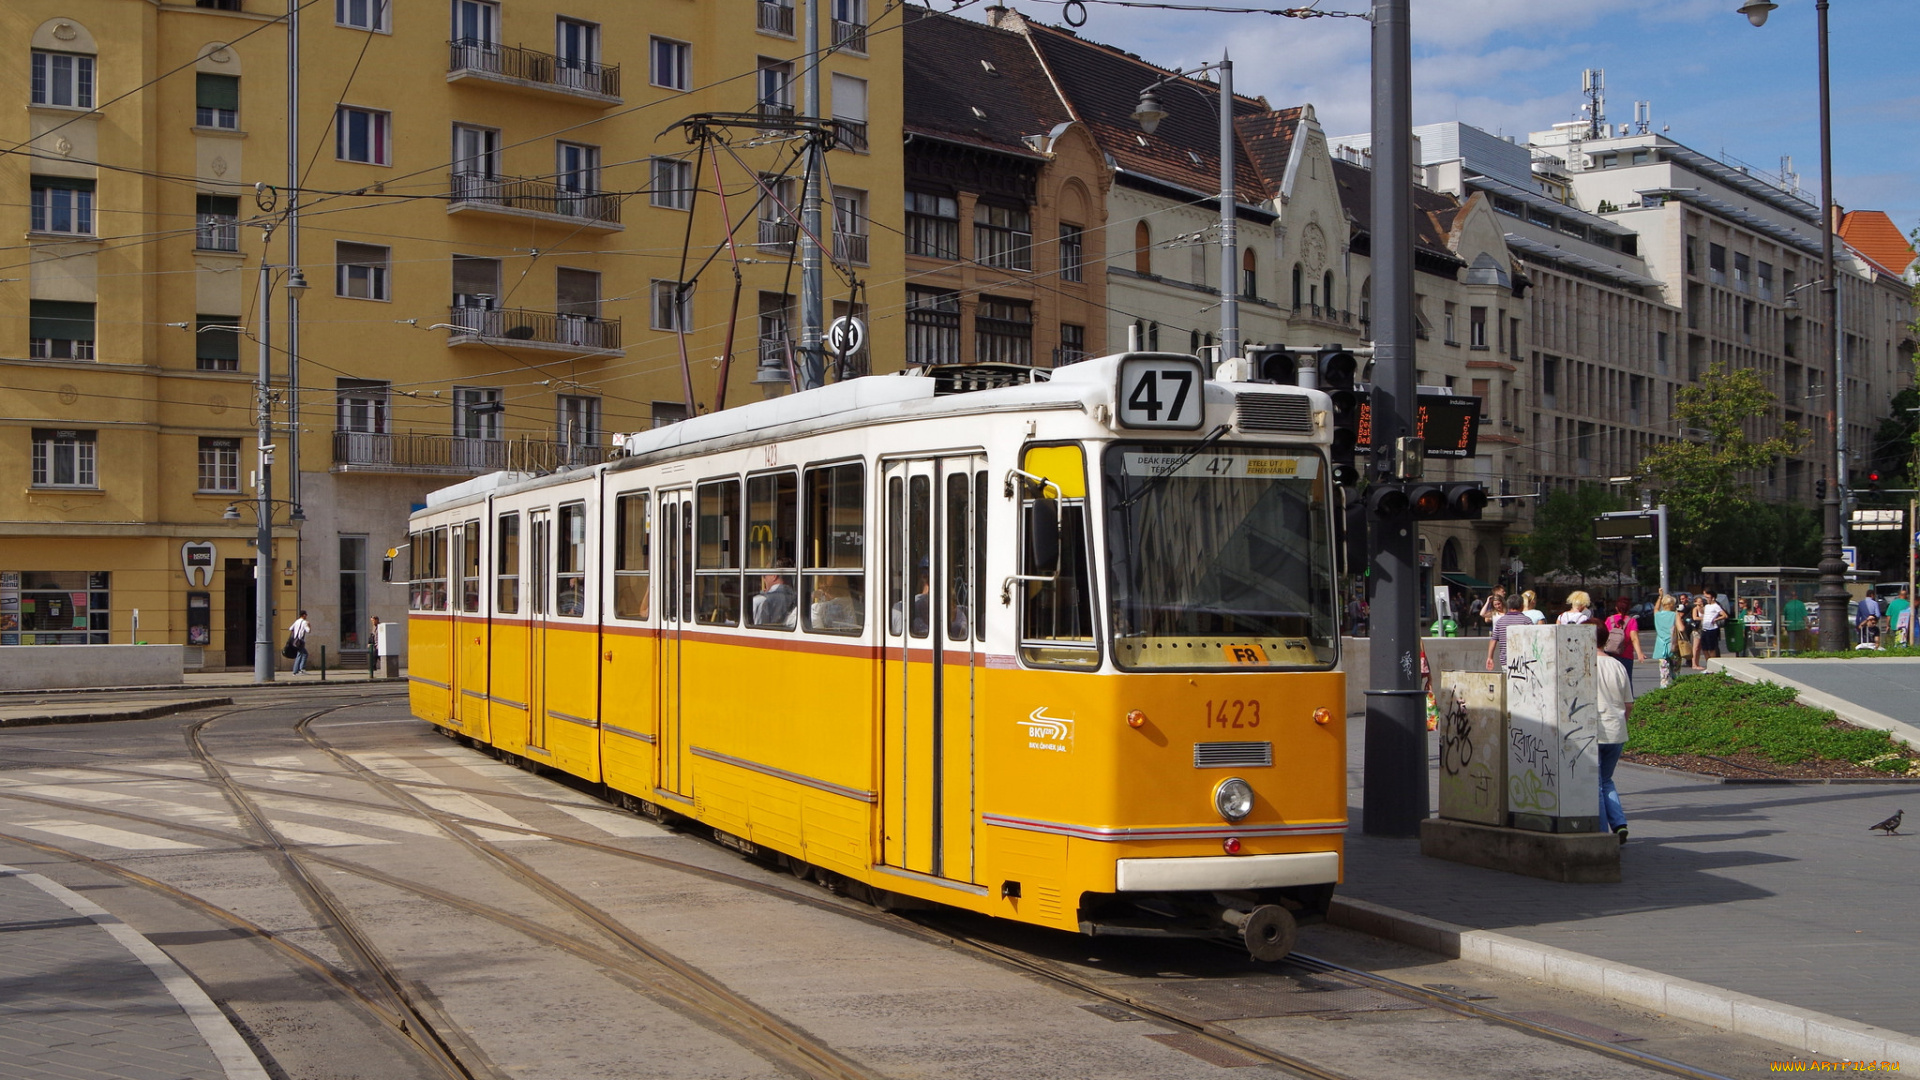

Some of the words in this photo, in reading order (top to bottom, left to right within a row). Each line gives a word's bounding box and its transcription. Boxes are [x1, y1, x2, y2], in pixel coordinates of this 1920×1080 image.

[1129, 370, 1192, 421] 47
[765, 444, 778, 467] 1423
[1138, 455, 1159, 464] DEÁK
[1206, 457, 1234, 475] 47
[1232, 648, 1260, 664] F8
[1206, 700, 1260, 729] 1423
[1029, 727, 1045, 738] BKV
